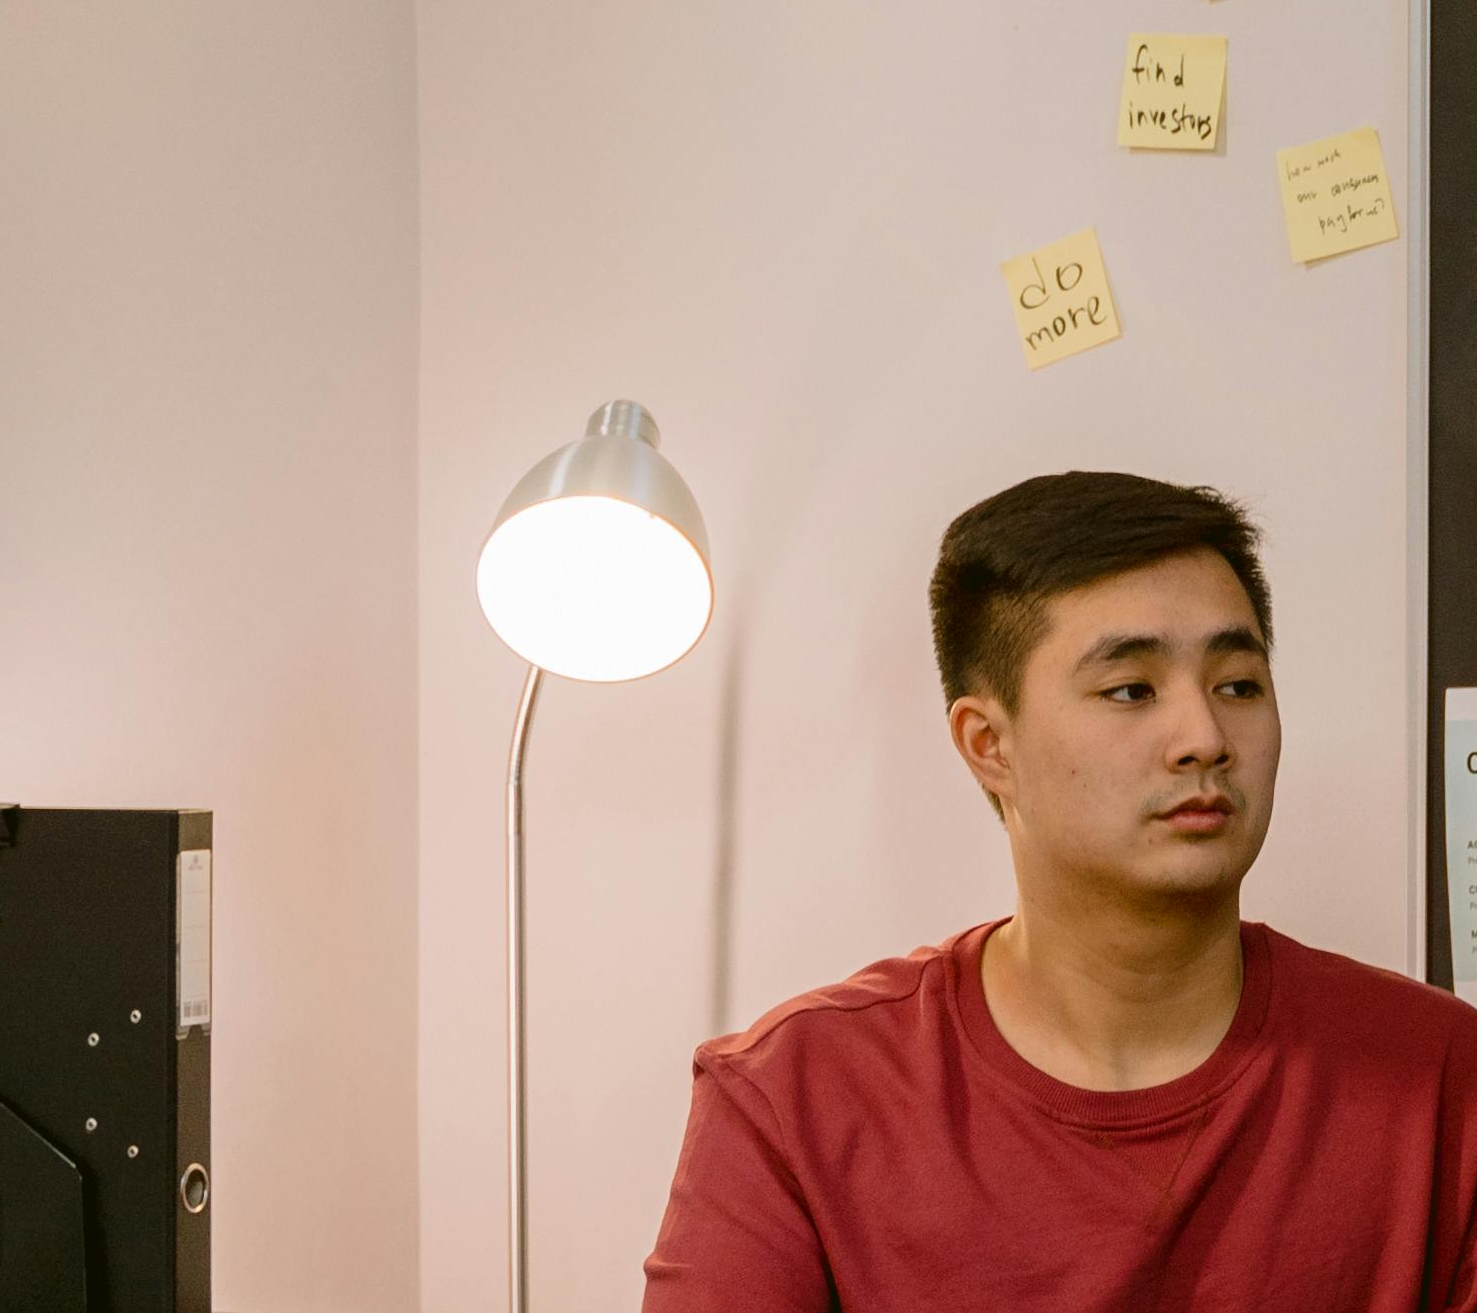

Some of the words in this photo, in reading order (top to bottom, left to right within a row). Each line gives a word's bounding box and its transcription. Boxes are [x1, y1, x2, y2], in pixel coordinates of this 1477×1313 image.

[1131, 44, 1184, 88] find
[1128, 100, 1212, 141] investors
[1019, 255, 1083, 310] do
[1024, 295, 1108, 351] more
